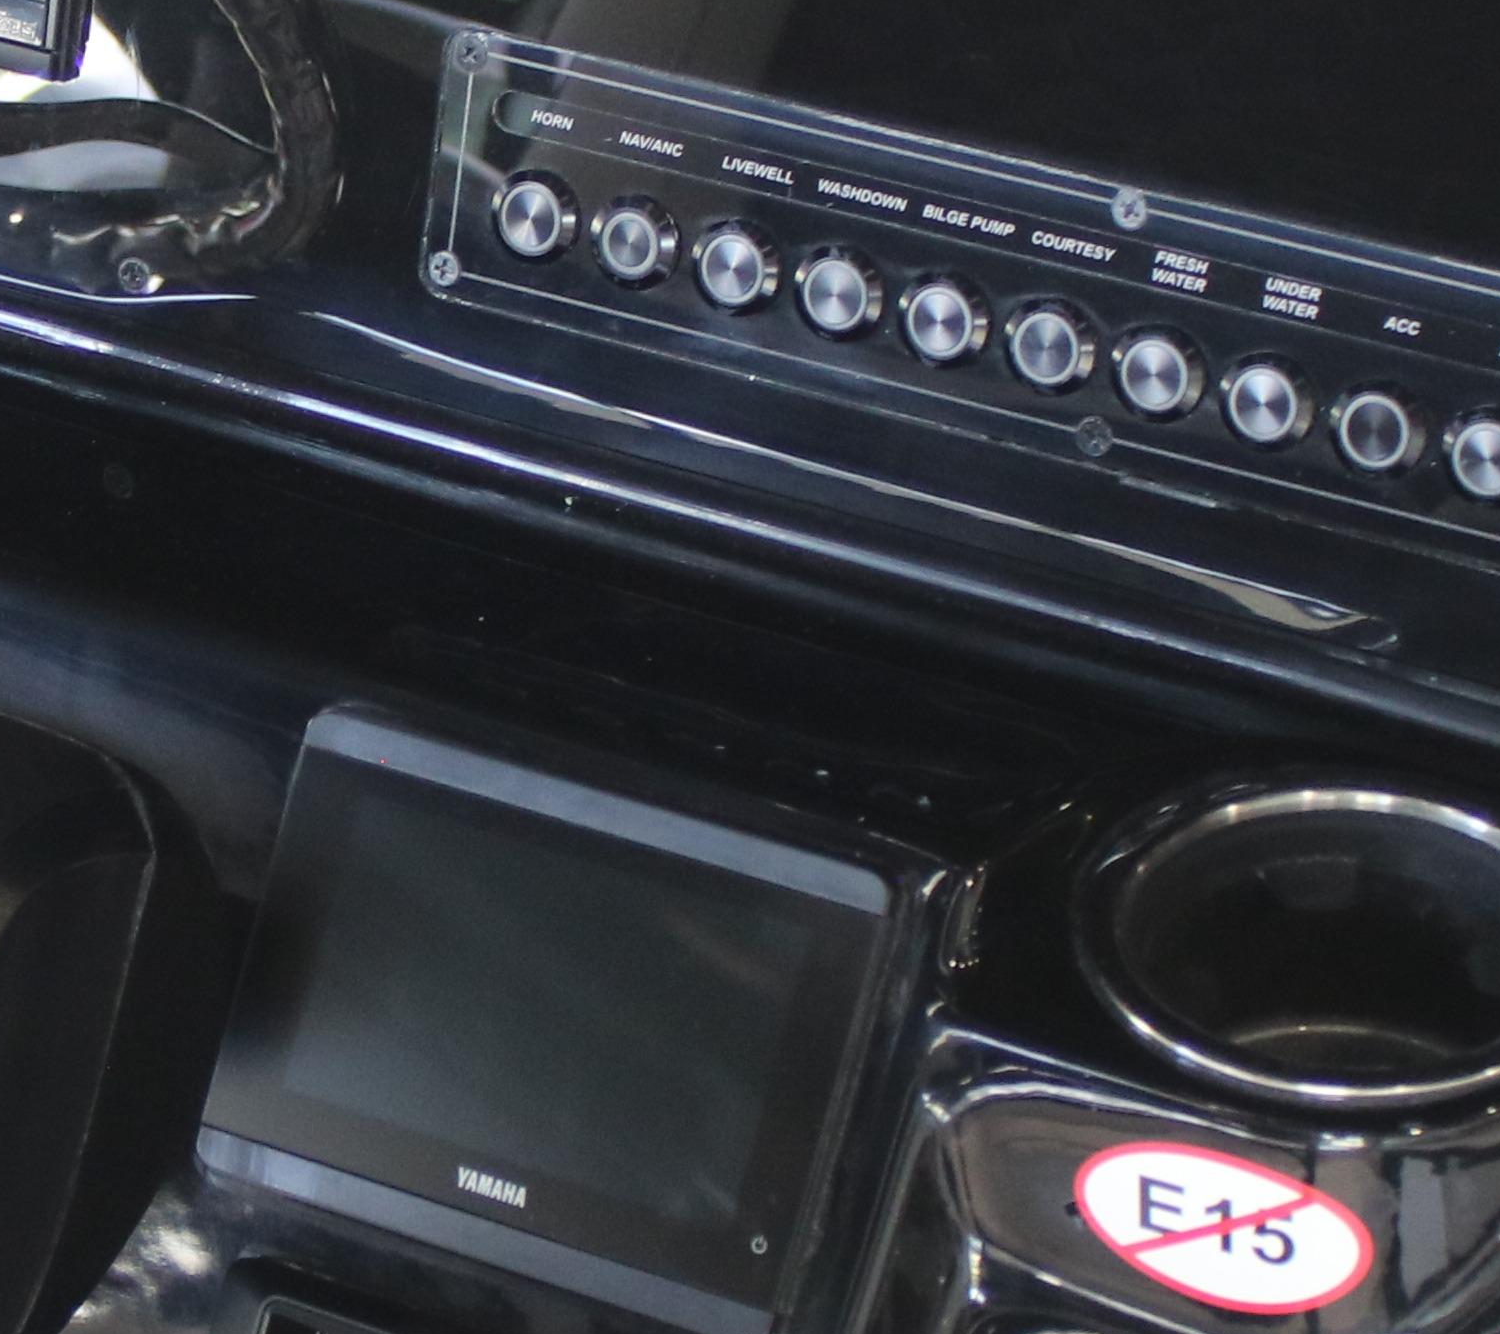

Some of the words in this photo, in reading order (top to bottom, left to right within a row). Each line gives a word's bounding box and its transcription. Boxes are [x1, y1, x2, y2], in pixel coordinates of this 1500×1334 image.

[530, 109, 574, 131] HORN
[619, 130, 684, 158] NAV/ANC
[722, 156, 794, 185] LIVEWELL
[817, 178, 908, 213] WASHDOWN
[922, 203, 969, 227] BILGE
[970, 216, 1016, 238] PUMP
[1031, 230, 1118, 263] COURTESY
[1155, 250, 1210, 275] FRESH
[1152, 267, 1207, 294] WATER
[1265, 276, 1322, 303] UNDER
[1262, 294, 1319, 320] WATER
[1384, 316, 1422, 337] ACC
[458, 1166, 527, 1209] YAMAHA
[1139, 1175, 1295, 1265] E15
